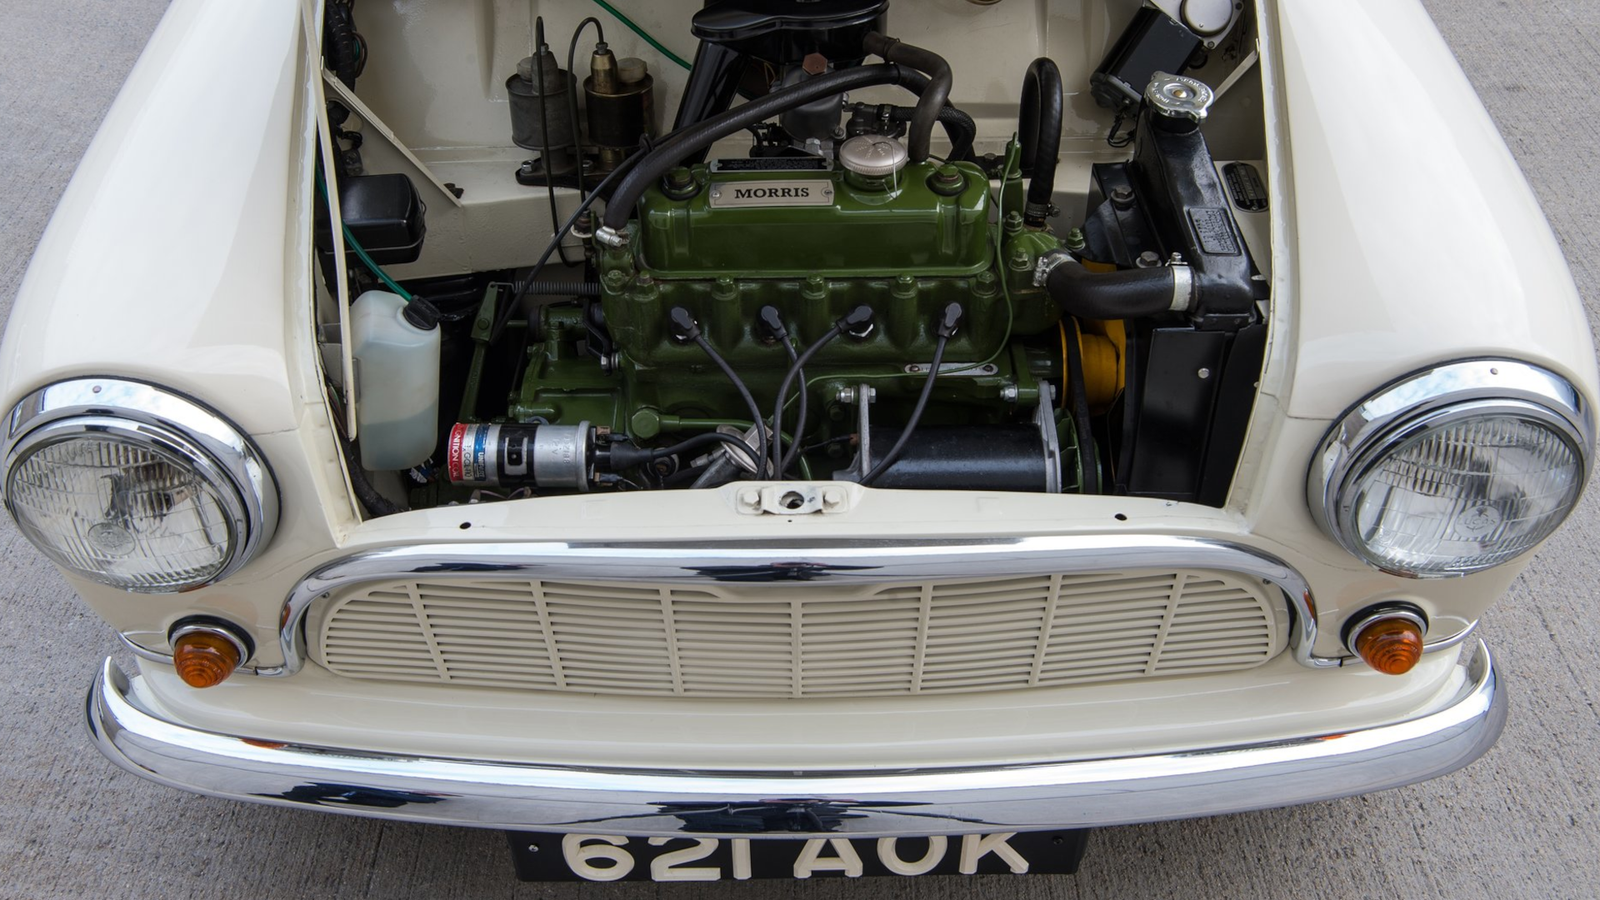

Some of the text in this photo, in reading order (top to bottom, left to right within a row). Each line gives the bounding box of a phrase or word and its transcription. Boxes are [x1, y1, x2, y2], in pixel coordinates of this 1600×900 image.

[734, 187, 809, 199] MORRIS
[561, 832, 1030, 882] 621 AOK
